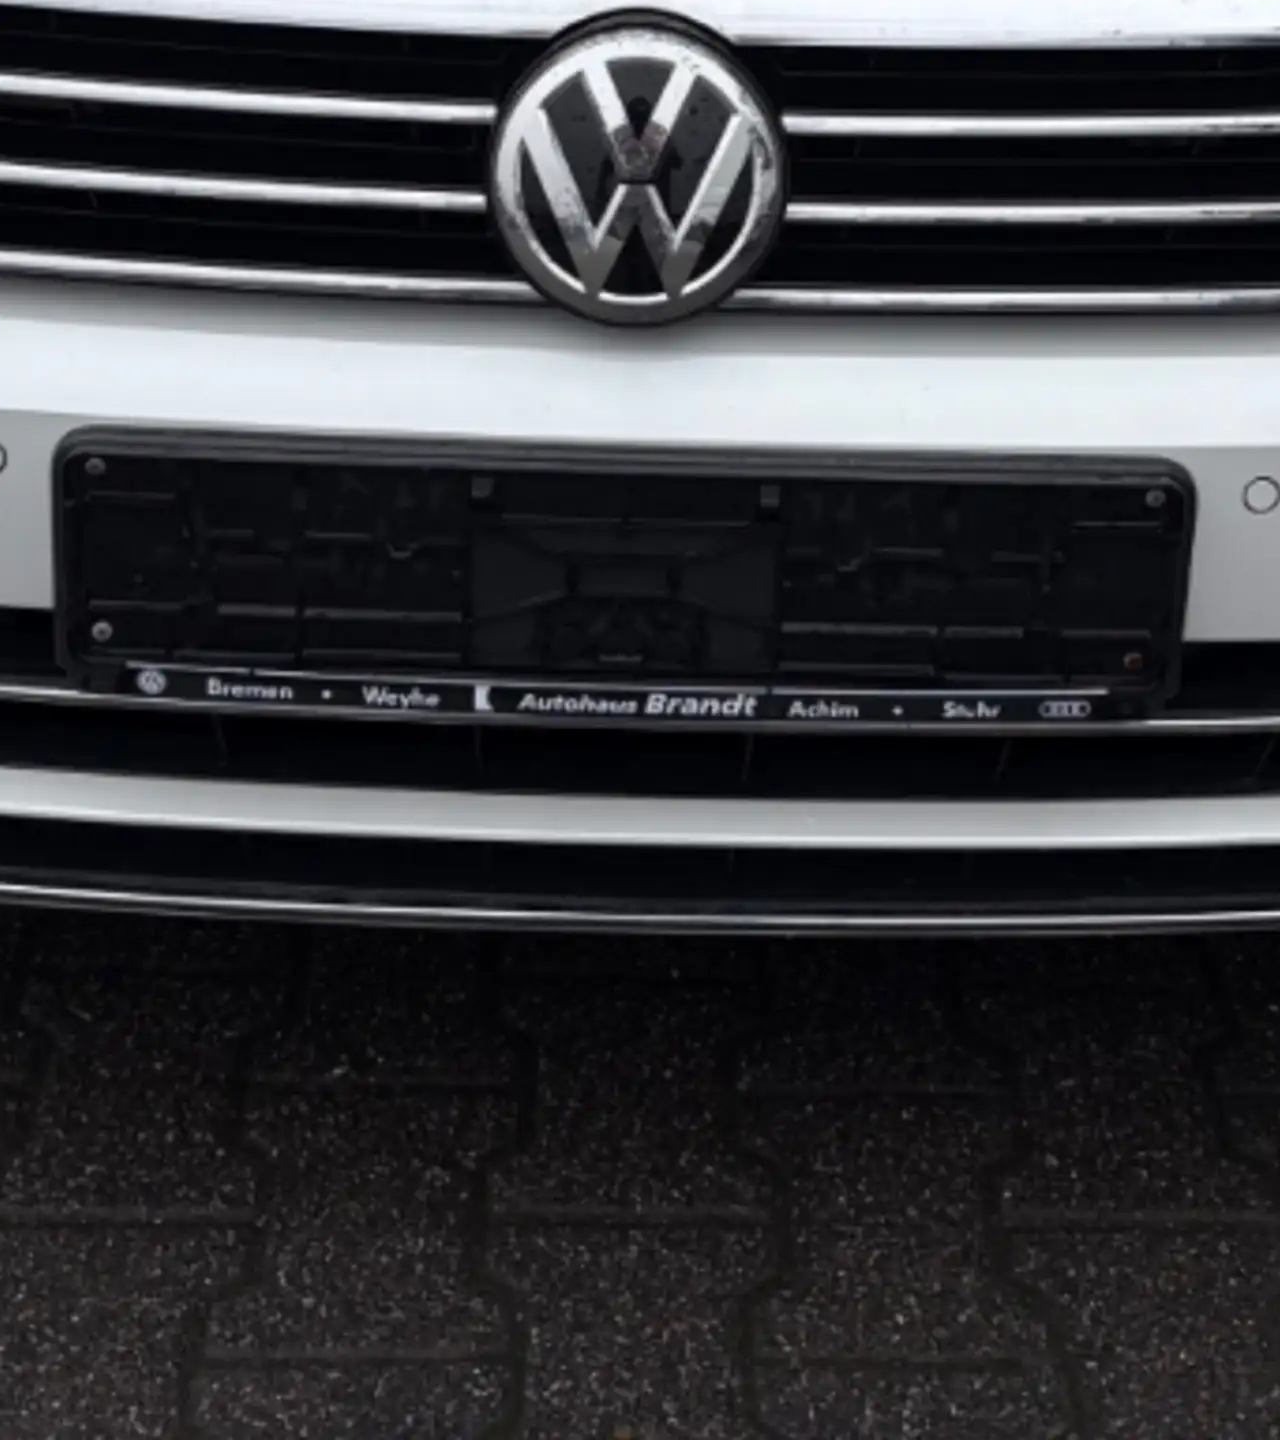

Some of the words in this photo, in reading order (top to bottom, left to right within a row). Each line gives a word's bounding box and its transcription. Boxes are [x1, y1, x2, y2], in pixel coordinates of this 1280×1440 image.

[207, 677, 294, 700] Bremen
[362, 685, 441, 709] Weyhe
[517, 692, 639, 714] Autohaus
[644, 693, 758, 717] Brandt
[786, 700, 860, 719] Achim
